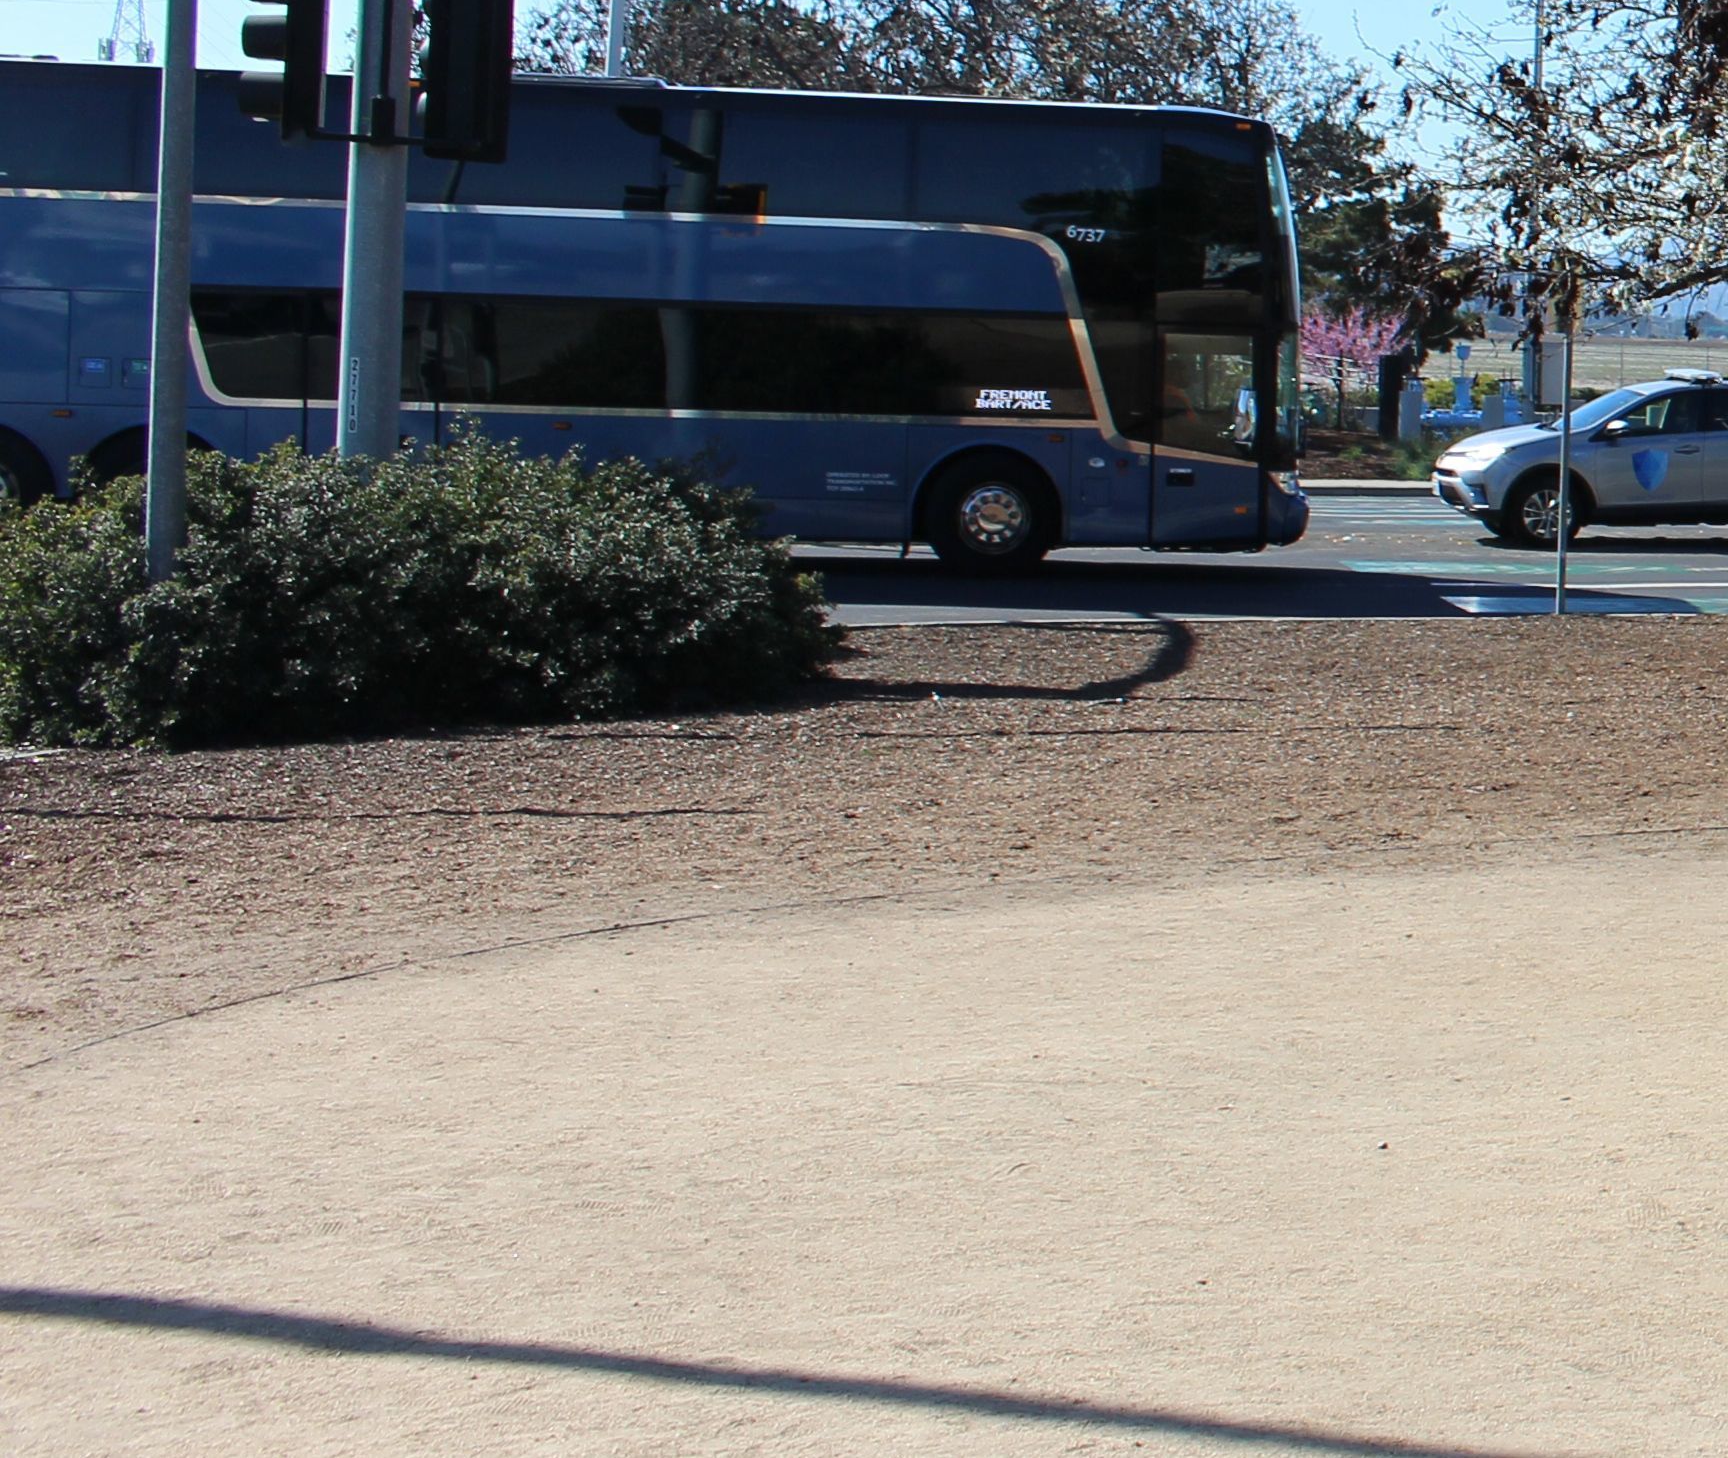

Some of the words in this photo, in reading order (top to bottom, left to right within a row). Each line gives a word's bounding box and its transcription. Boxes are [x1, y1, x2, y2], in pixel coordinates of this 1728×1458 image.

[1066, 225, 1106, 242] 6737
[349, 358, 359, 431] 27710
[980, 389, 1047, 400] FREMONT
[975, 399, 1052, 411] BART/ACE
